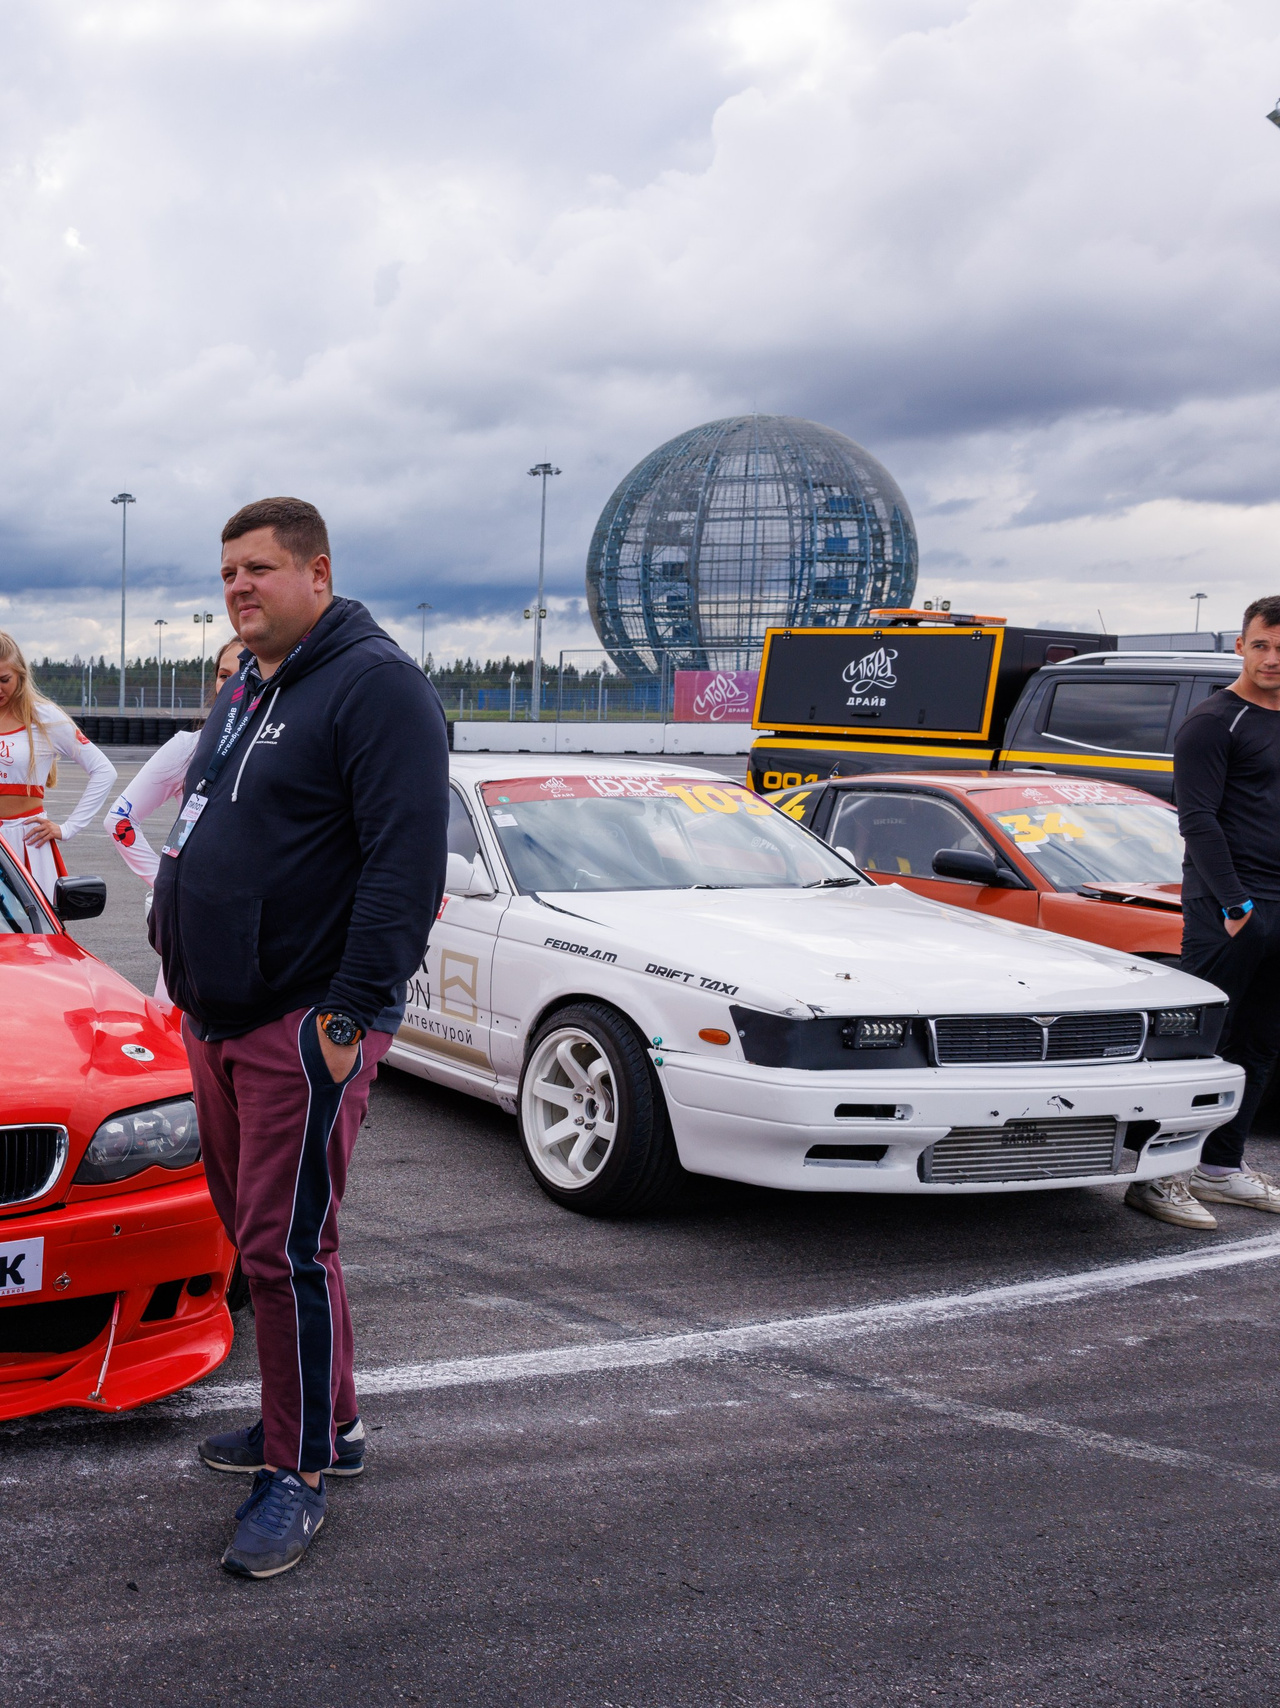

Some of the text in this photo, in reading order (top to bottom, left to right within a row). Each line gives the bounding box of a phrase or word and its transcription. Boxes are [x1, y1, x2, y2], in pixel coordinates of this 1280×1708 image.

[846, 696, 887, 706] ДРАЙВ
[221, 716, 249, 756] drive-igora.ru
[224, 707, 237, 734] ДРАЙВ
[587, 779, 668, 794] IDDC
[663, 784, 774, 817] 103
[997, 812, 1086, 843] 34
[644, 963, 740, 996] DRIFT TAXI
